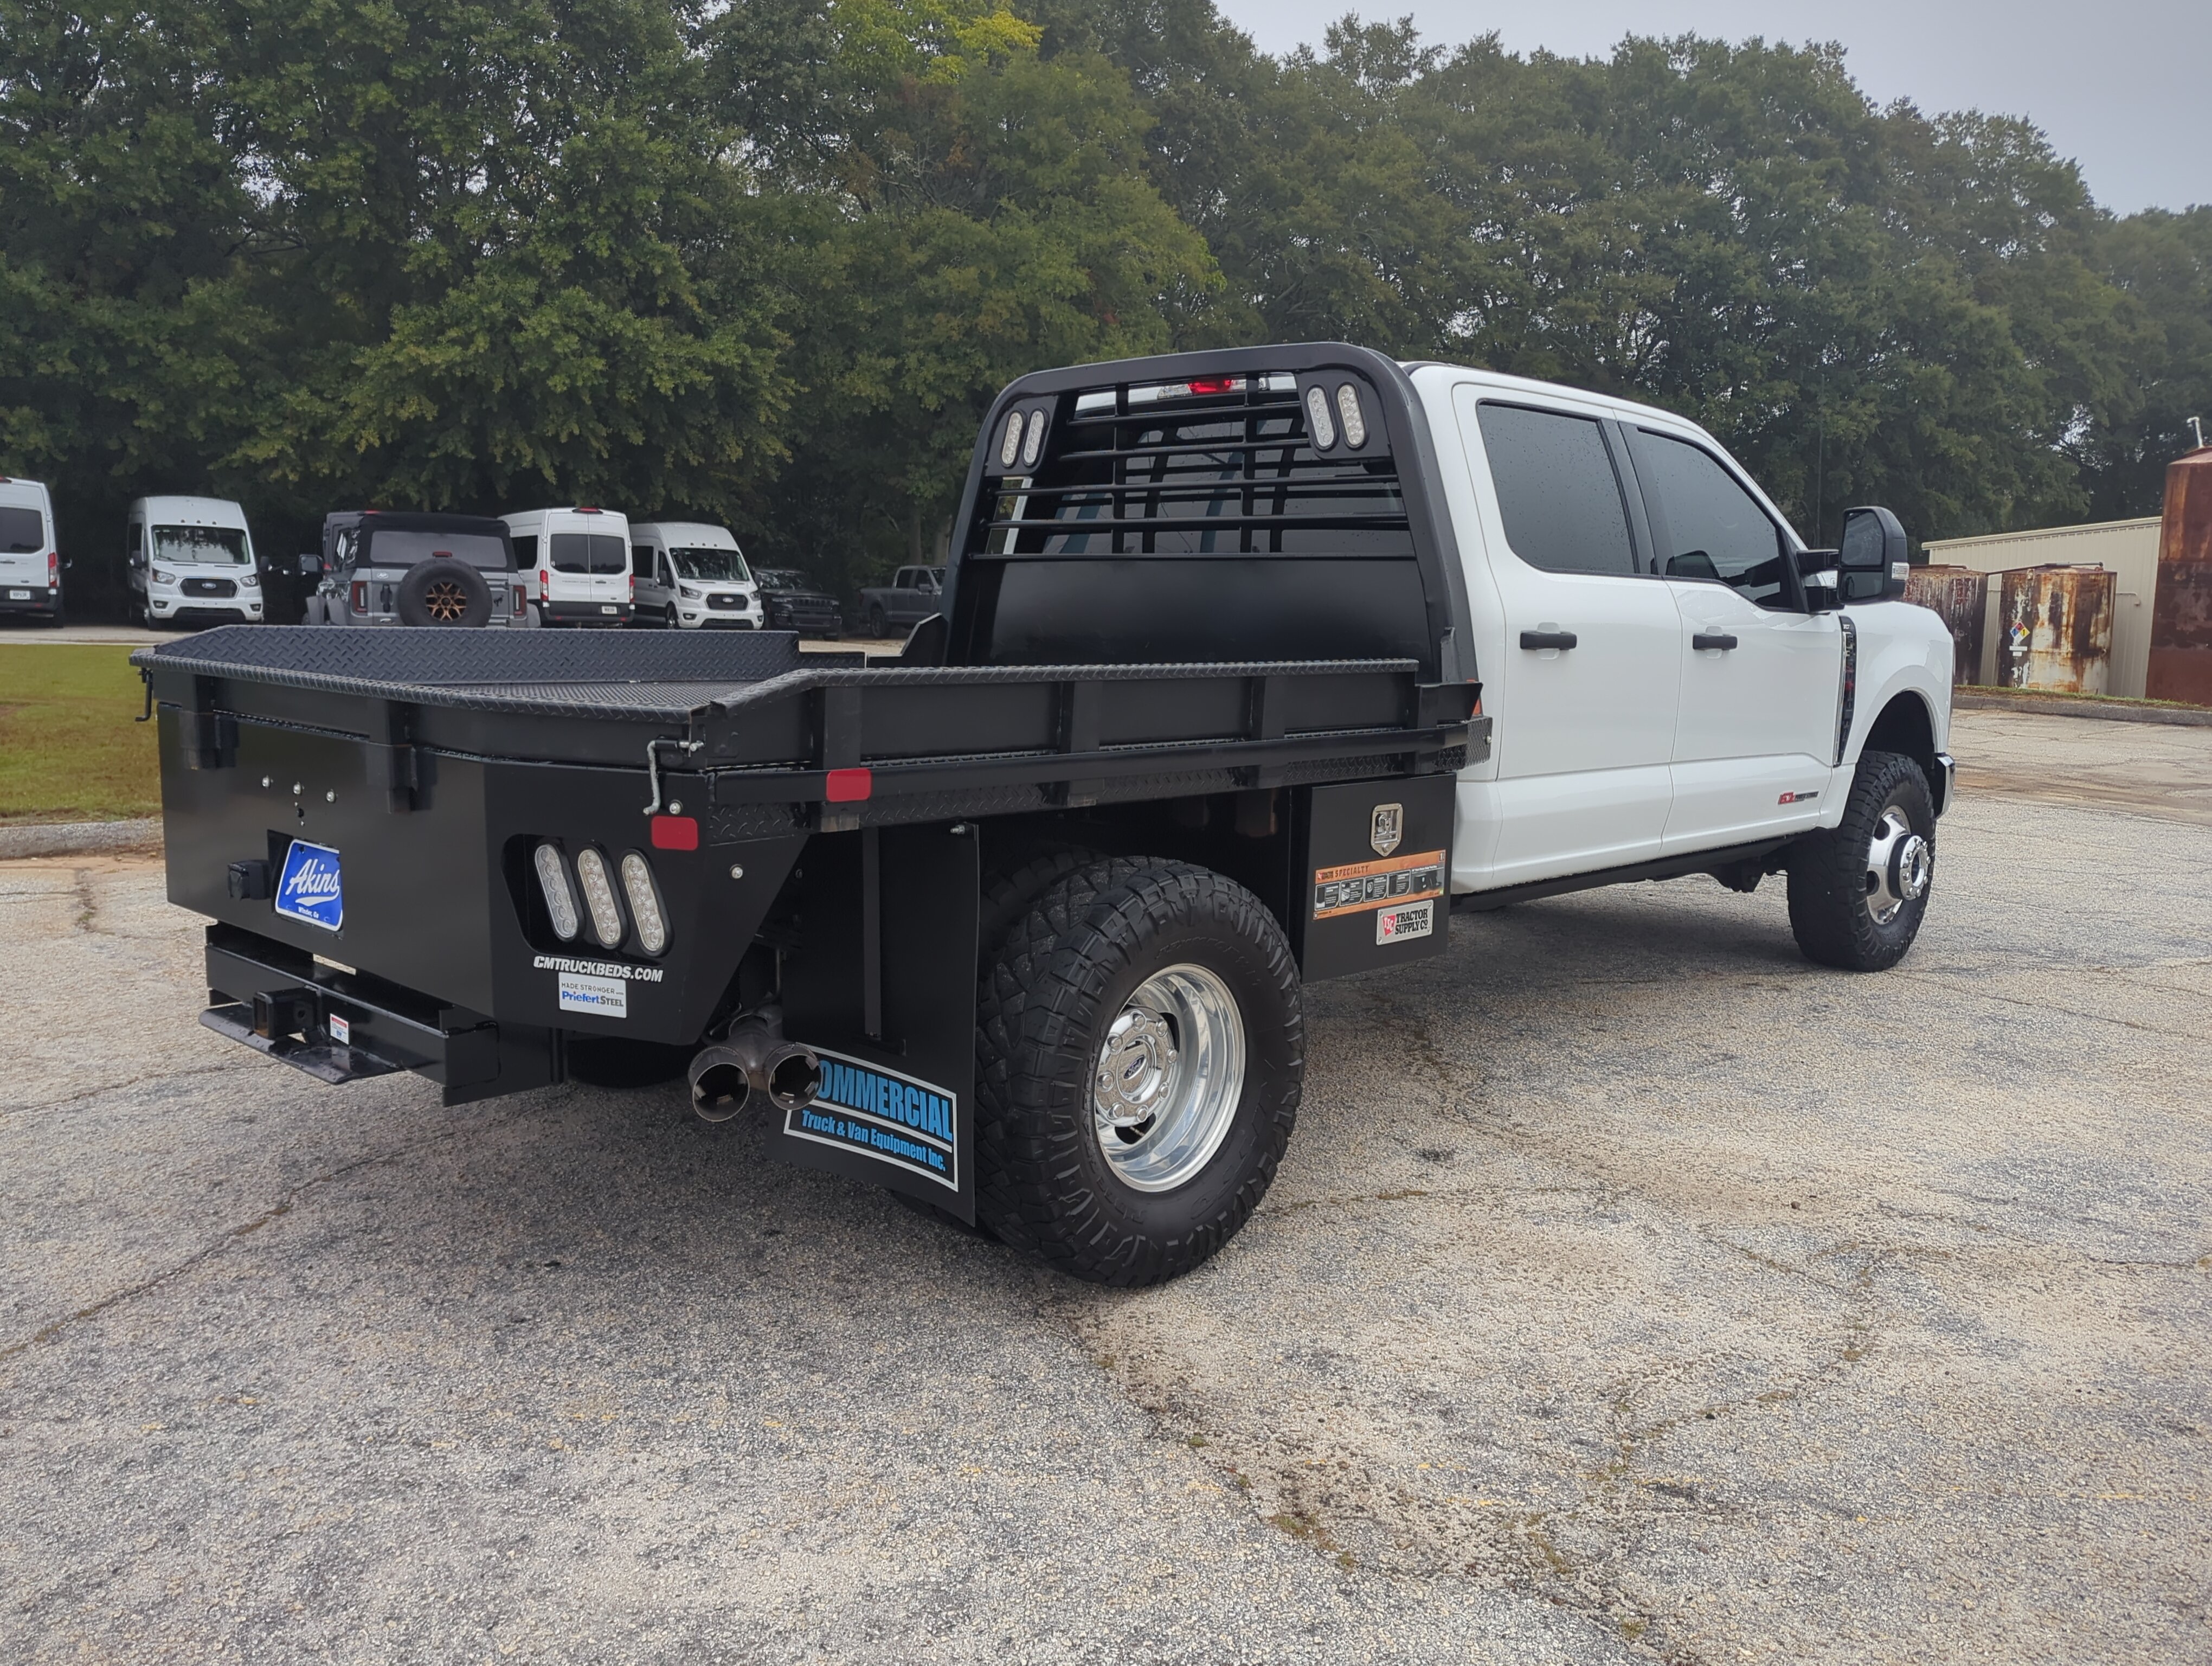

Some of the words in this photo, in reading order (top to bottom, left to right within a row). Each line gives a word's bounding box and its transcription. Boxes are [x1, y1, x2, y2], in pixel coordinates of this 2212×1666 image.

[285, 858, 340, 895] Akins
[1335, 865, 1369, 877] SPECIALTY
[1396, 908, 1428, 923] TRACTOR
[1384, 917, 1394, 932] TSC
[1395, 920, 1420, 935] SUPPLY
[533, 956, 664, 982] CMTRUCKBEDS.COM
[580, 984, 615, 995] STRONGER
[816, 1060, 953, 1142] OMMERCIAL
[802, 1110, 835, 1134] Truck
[837, 1121, 846, 1137] &
[847, 1121, 869, 1143] Van
[870, 1127, 928, 1163] Equipment
[928, 1148, 946, 1172] Inc.
